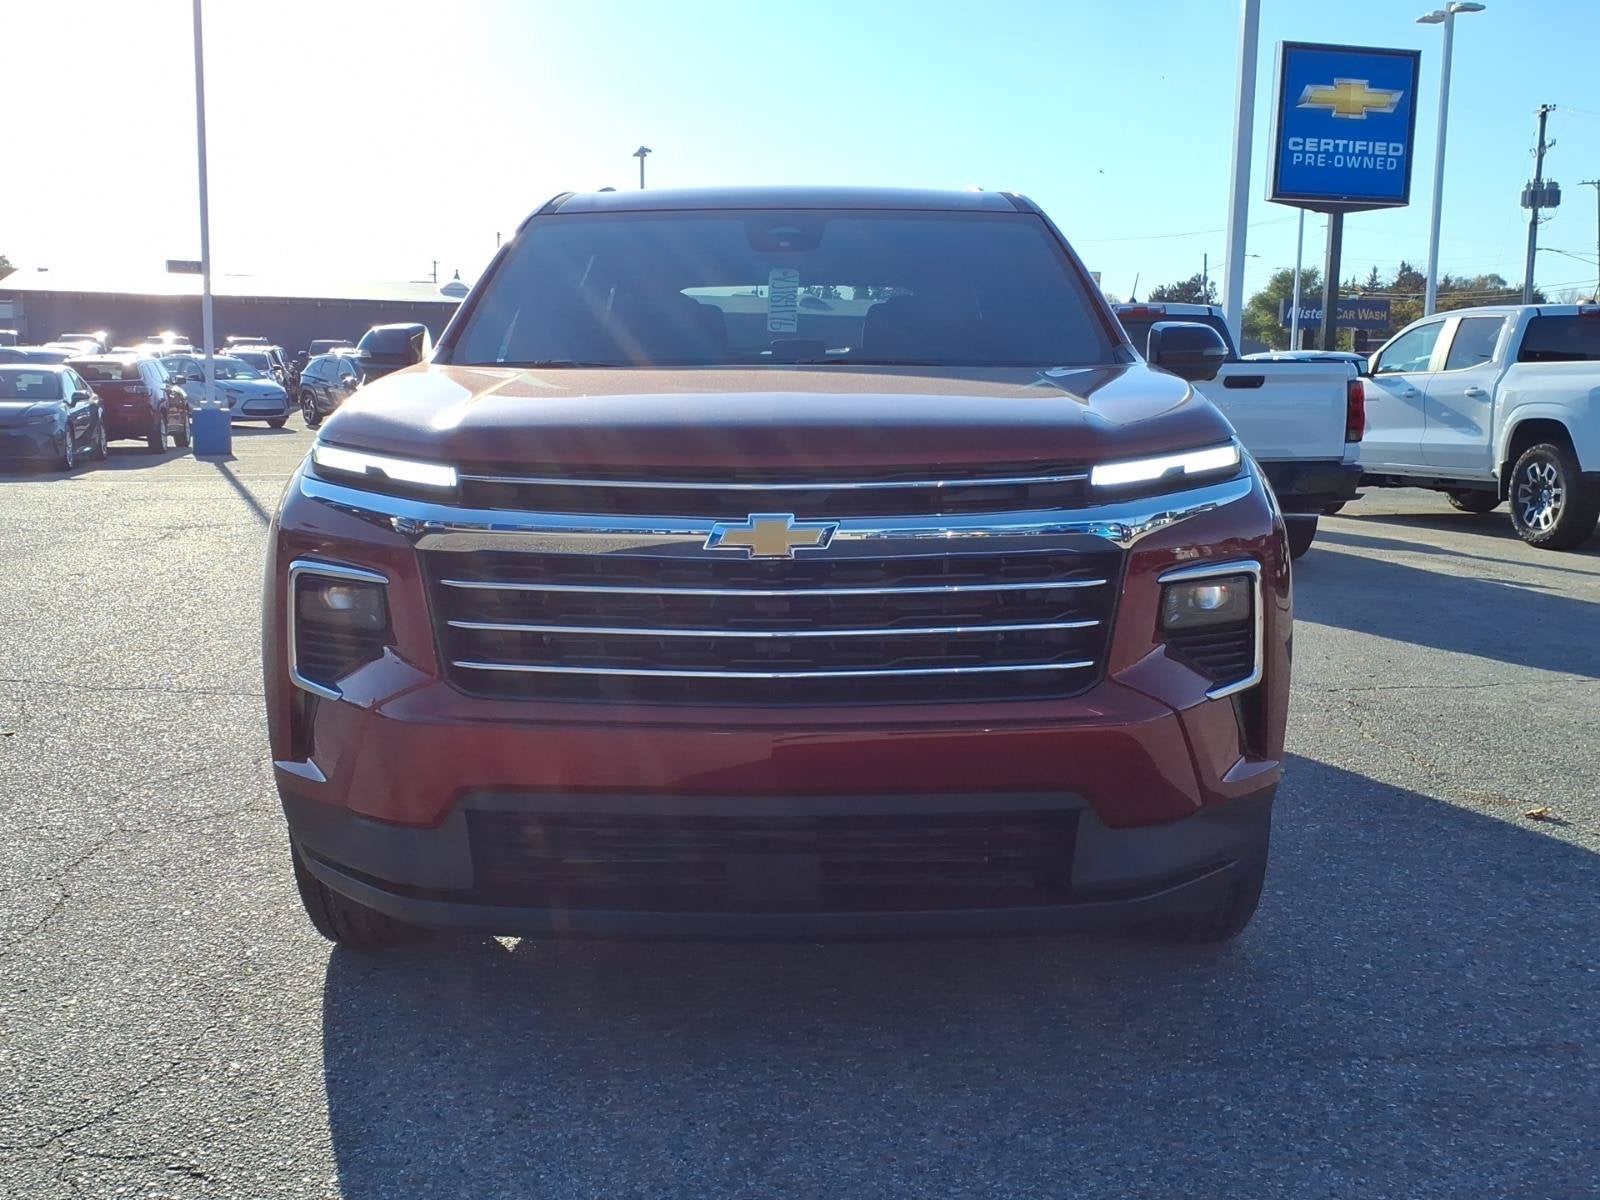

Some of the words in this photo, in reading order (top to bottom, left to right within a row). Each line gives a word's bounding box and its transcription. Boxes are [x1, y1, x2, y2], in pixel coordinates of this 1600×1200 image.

[1288, 137, 1404, 156] CERTIFIED
[1293, 153, 1397, 171] PRE-OWNED
[1286, 306, 1326, 320] Miste
[1358, 308, 1387, 321] WASH
